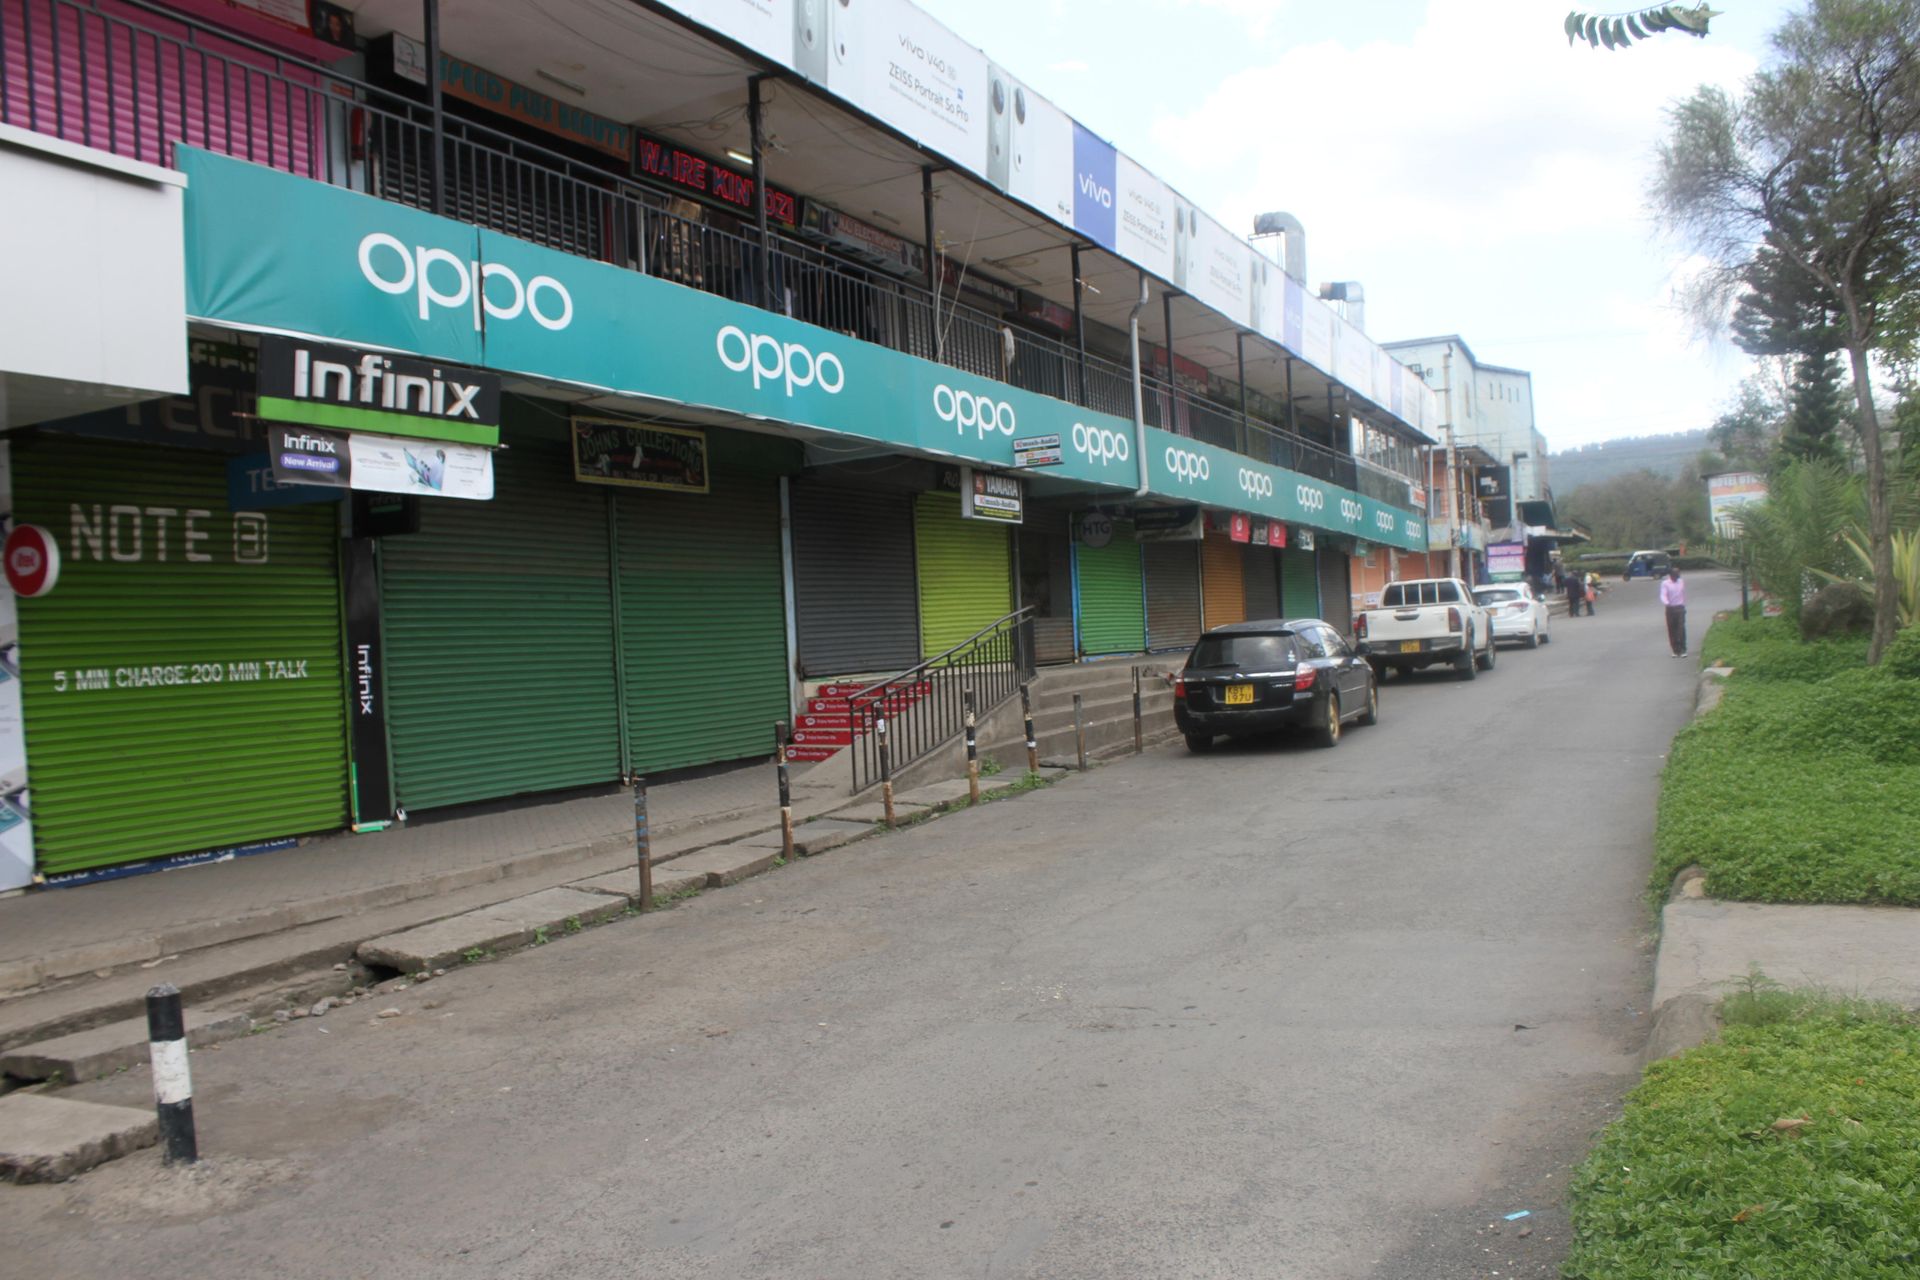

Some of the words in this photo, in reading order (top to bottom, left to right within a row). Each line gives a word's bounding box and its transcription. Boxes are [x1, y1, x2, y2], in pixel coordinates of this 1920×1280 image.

[639, 138, 707, 190] WAIRE
[712, 166, 795, 225] KINOZI
[1079, 172, 1112, 209] vivo
[358, 233, 573, 331] oppo
[716, 325, 844, 398] oppo
[294, 349, 481, 420] Infinix
[933, 384, 1015, 441] oppo
[284, 433, 336, 454] Infinix
[1073, 423, 1129, 467] oppo
[284, 456, 306, 467] New
[306, 457, 336, 470] Arrival
[1165, 447, 1210, 485] oppo
[986, 474, 1018, 497] YAMAHA
[1239, 467, 1272, 501] oppo
[1297, 484, 1324, 513] oppo
[1082, 521, 1111, 536] HTG
[1341, 498, 1363, 524] oppo
[1376, 510, 1394, 534] oppo
[70, 503, 213, 562] NOTE
[54, 670, 68, 692] 5
[75, 669, 110, 691] MIN
[228, 662, 260, 682] MIN
[265, 660, 309, 680] TALK
[357, 644, 375, 715] Infinix
